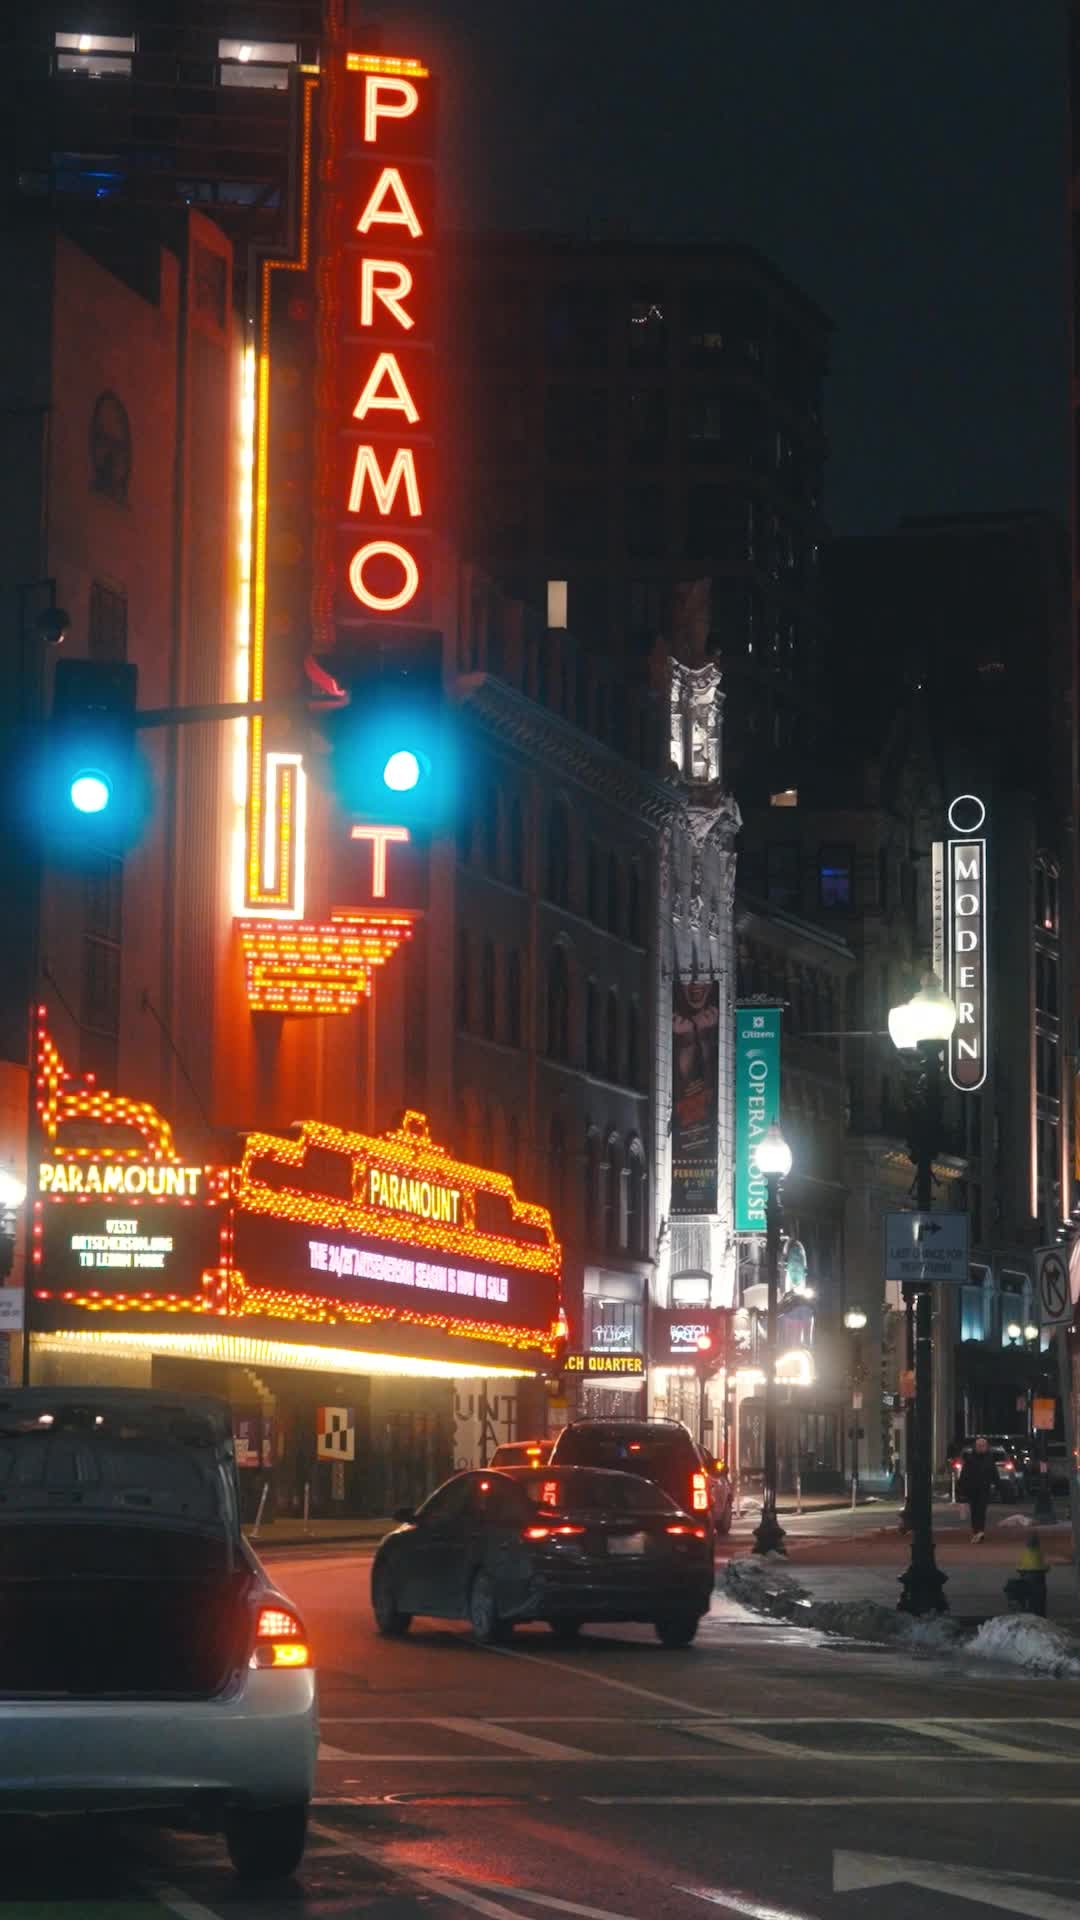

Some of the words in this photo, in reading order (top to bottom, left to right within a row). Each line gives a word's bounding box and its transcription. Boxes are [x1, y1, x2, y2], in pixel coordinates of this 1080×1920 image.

[347, 76, 424, 897] PARAMOT
[956, 859, 979, 1059] MODERN
[742, 1030, 775, 1039] Citizens
[748, 1060, 769, 1137] OPERA
[39, 1163, 202, 1196] PARAMOUNT
[370, 1169, 460, 1225] PARAMOUNT
[564, 1356, 584, 1370] CH
[588, 1357, 642, 1372] QUARTER
